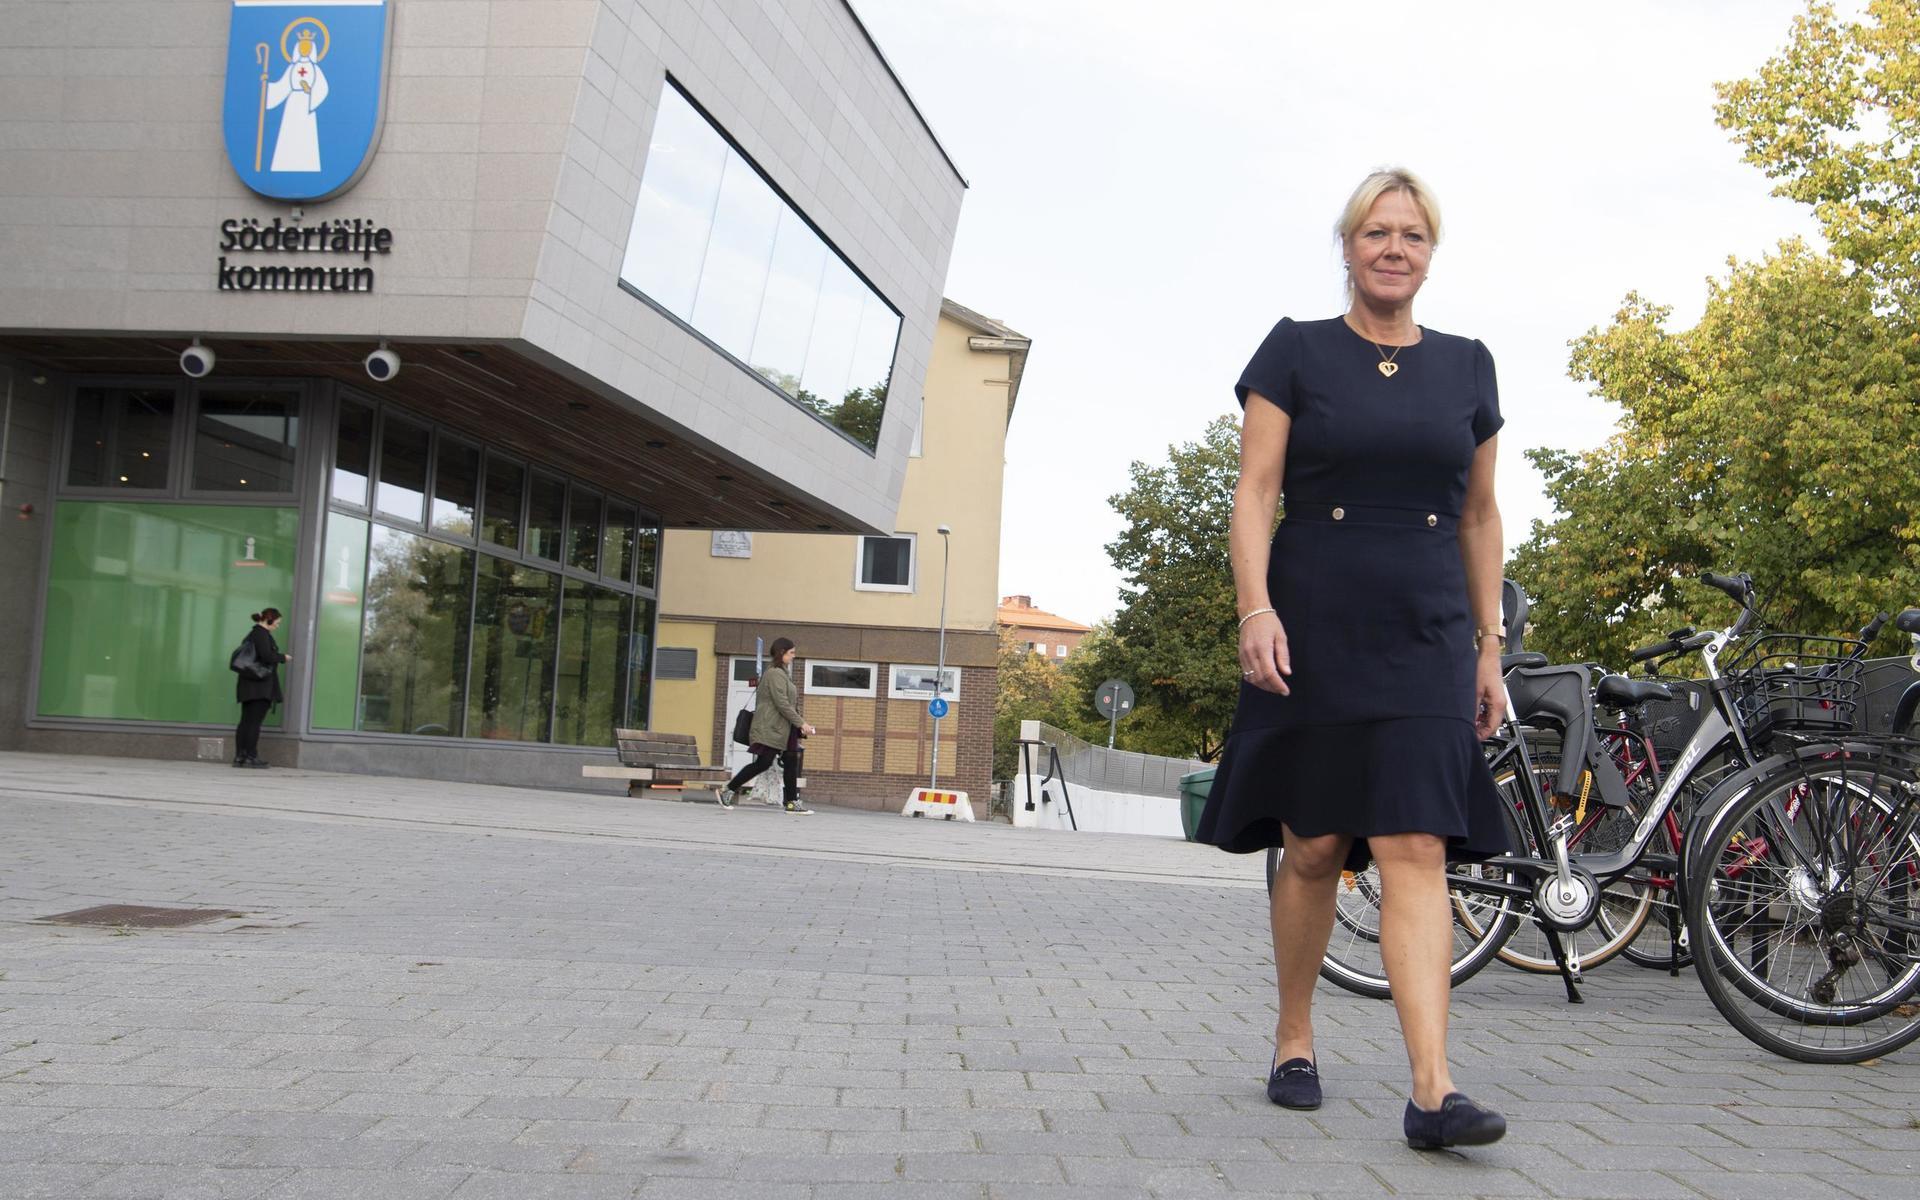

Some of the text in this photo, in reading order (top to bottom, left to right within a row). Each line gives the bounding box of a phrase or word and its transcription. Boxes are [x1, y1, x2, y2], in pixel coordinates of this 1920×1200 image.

[220, 218, 392, 261] Södertälje
[218, 257, 374, 292] kommun
[1634, 738, 1701, 843] Crescent
